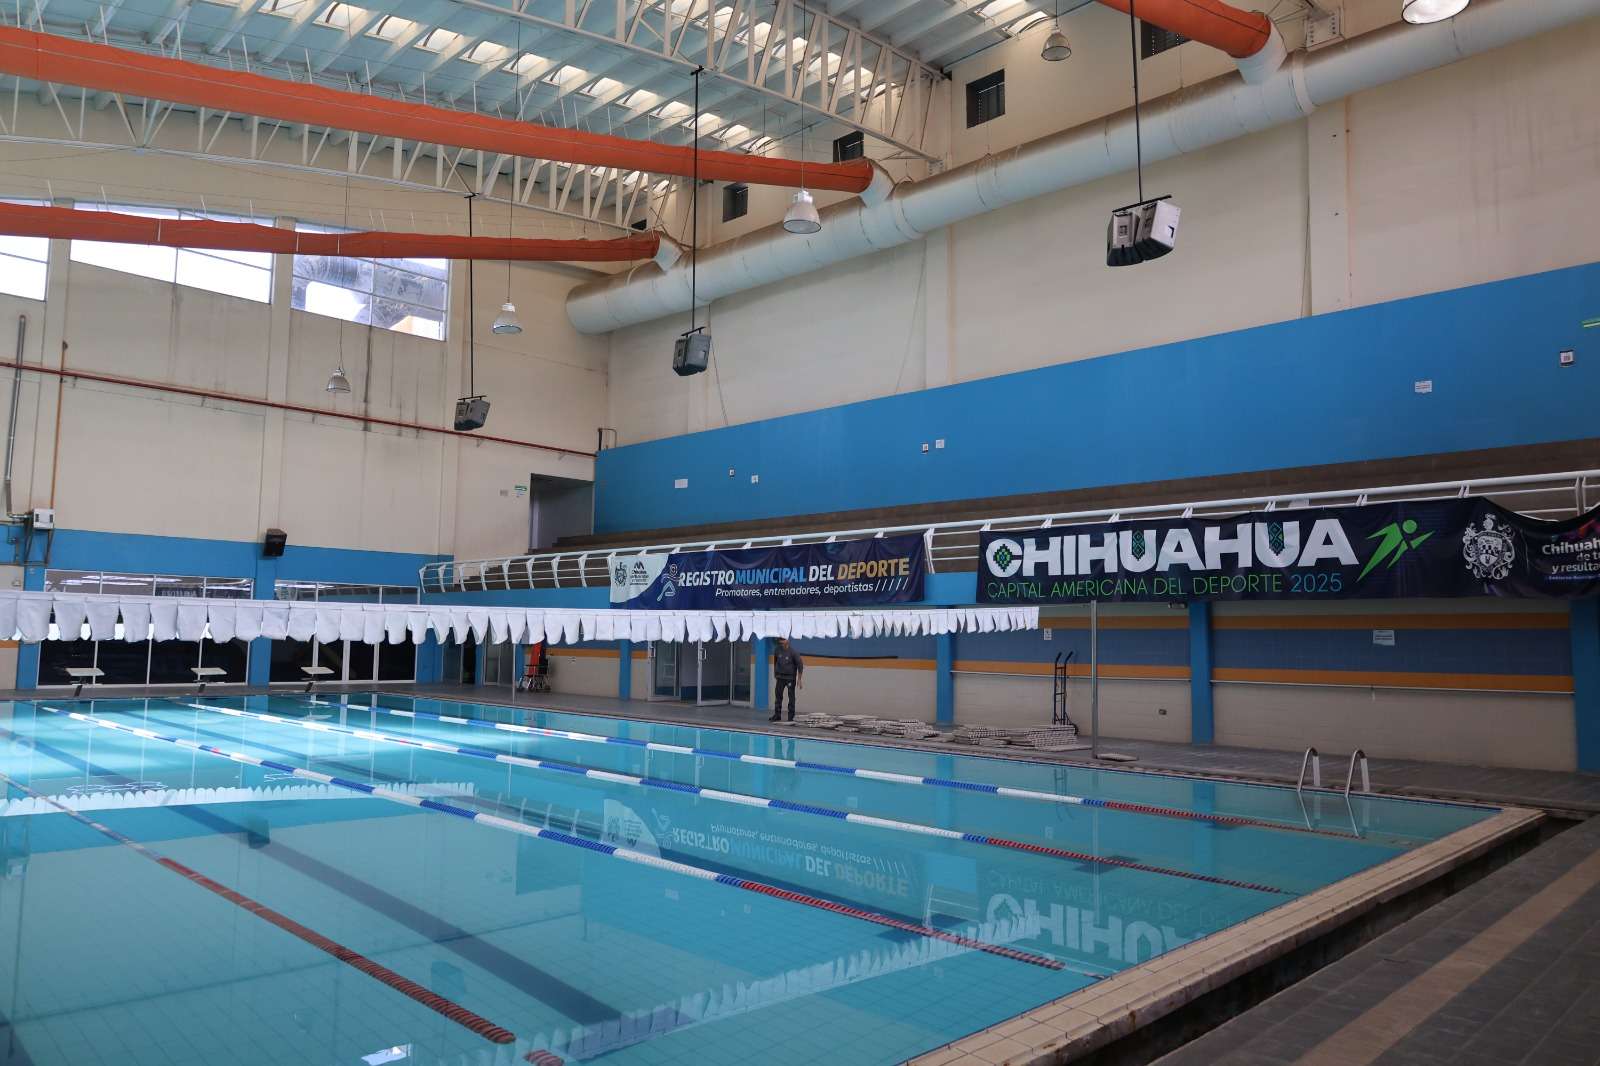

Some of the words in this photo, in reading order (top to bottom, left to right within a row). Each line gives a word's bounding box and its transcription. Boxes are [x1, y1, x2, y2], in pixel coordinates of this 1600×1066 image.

[985, 518, 1360, 578] CHIHUAHUA
[1576, 552, 1591, 561] de
[678, 569, 735, 587] REGISTRO
[735, 566, 807, 585] MUNICIPAL
[808, 564, 834, 582] DEL
[837, 558, 910, 580] DEPORTE
[1551, 565, 1559, 575] y
[715, 588, 762, 597] Promotores,
[763, 585, 821, 596] entrenadores,
[987, 582, 1046, 598] CAPITAL
[1050, 577, 1148, 597] AMERICANA
[1153, 577, 1187, 595] DEL
[1193, 574, 1282, 594] DEPORTE
[1290, 572, 1343, 592] 2025
